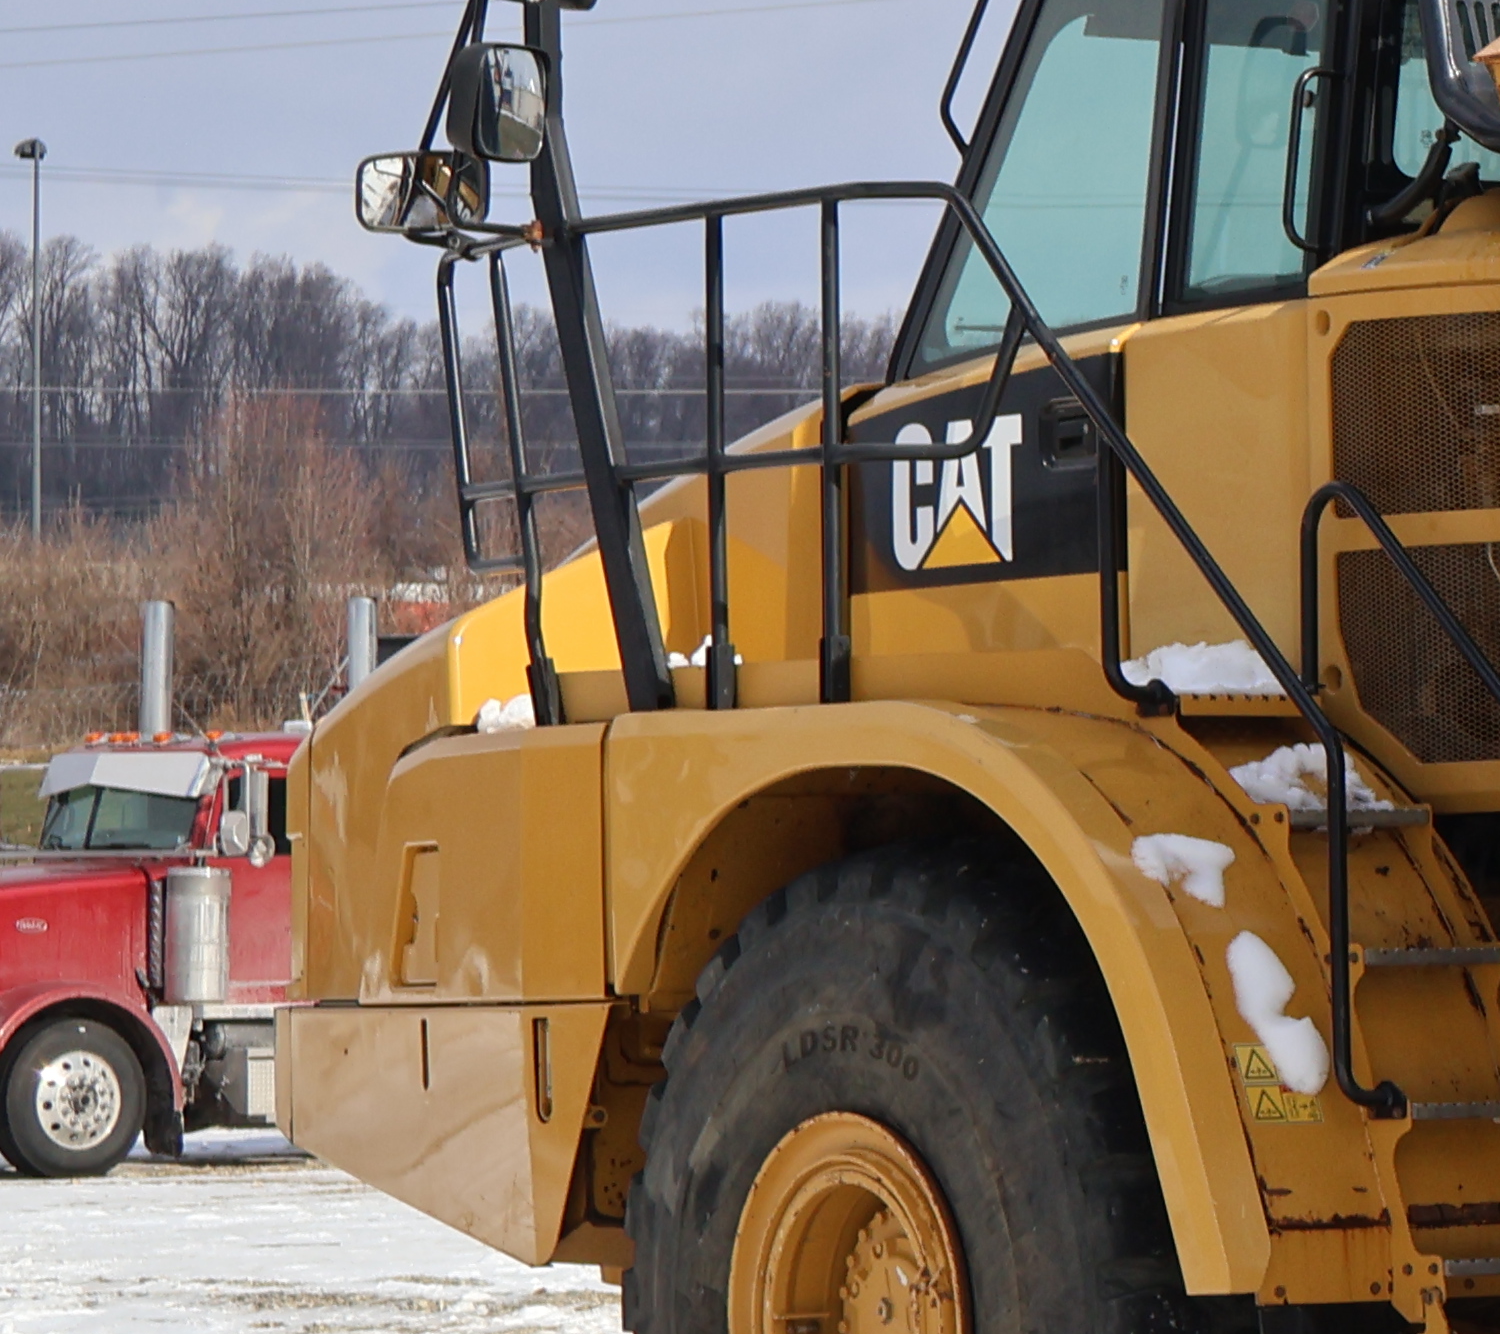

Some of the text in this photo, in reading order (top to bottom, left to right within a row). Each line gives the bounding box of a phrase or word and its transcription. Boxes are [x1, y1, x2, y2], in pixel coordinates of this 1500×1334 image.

[892, 413, 1023, 572] CAT
[782, 1024, 920, 1082] LDSR 300
